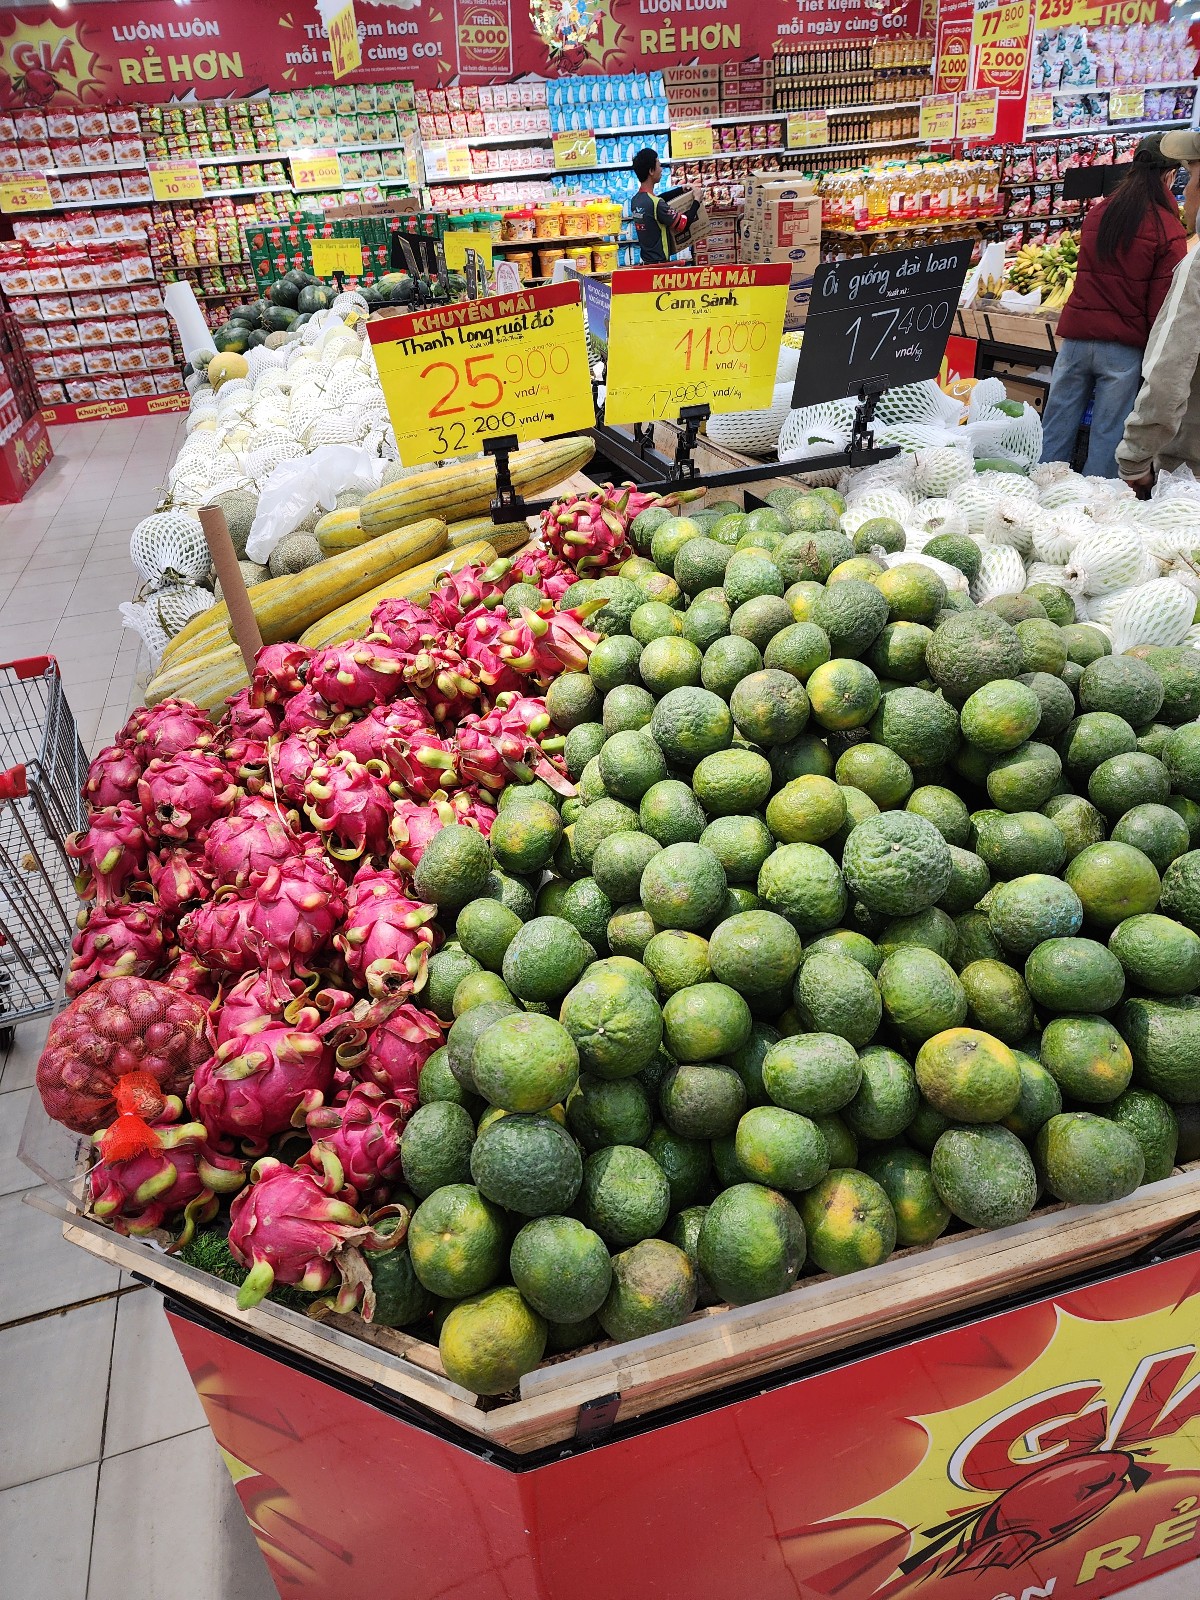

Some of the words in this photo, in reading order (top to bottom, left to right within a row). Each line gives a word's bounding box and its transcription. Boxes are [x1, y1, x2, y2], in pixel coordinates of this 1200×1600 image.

[387, 20, 418, 35] hơn
[472, 14, 496, 24] TRÊN
[777, 17, 804, 35] mỗi
[807, 18, 841, 34] ngày
[845, 16, 878, 32] cùng
[882, 15, 908, 28] GO!
[982, 5, 1024, 36] 77.800
[112, 20, 164, 42] LUÔN
[168, 18, 220, 38] LUÔN
[461, 29, 507, 44] 2.000
[640, 18, 676, 54] RẺ
[680, 22, 741, 52] HƠN
[10, 35, 78, 78] GIÁ
[286, 44, 318, 64] mỗi
[368, 44, 408, 60] cùng
[412, 42, 442, 58] GO!
[982, 52, 1024, 67] 2.000
[118, 44, 166, 85] RẺ
[168, 51, 244, 82] HƠN
[941, 58, 966, 74] 2.000
[668, 70, 700, 80] VIFON
[668, 88, 700, 99] VIFON
[669, 106, 702, 118] VIFON
[652, 268, 722, 290] KHUYẾN
[726, 267, 756, 285] MÃI
[822, 263, 839, 296] Ổi
[849, 262, 890, 300] giống
[896, 256, 920, 277] đài
[926, 252, 958, 272] loan
[656, 292, 696, 312] Cam
[412, 302, 494, 334] KHUYẾN
[499, 294, 536, 314] MÃI
[396, 330, 454, 356] Thanh
[530, 308, 554, 330] đỏ
[846, 302, 948, 365] 17.400
[674, 322, 767, 370] 11.800
[895, 343, 922, 362] vnd/kg
[716, 359, 748, 373] vnd/kg
[420, 346, 570, 418] 25.900
[514, 384, 550, 399] vnd/kg
[78, 405, 108, 417] Khuyến
[110, 404, 126, 413] Mãi!
[149, 398, 178, 409] Khuyến
[428, 411, 516, 454] 32.200
